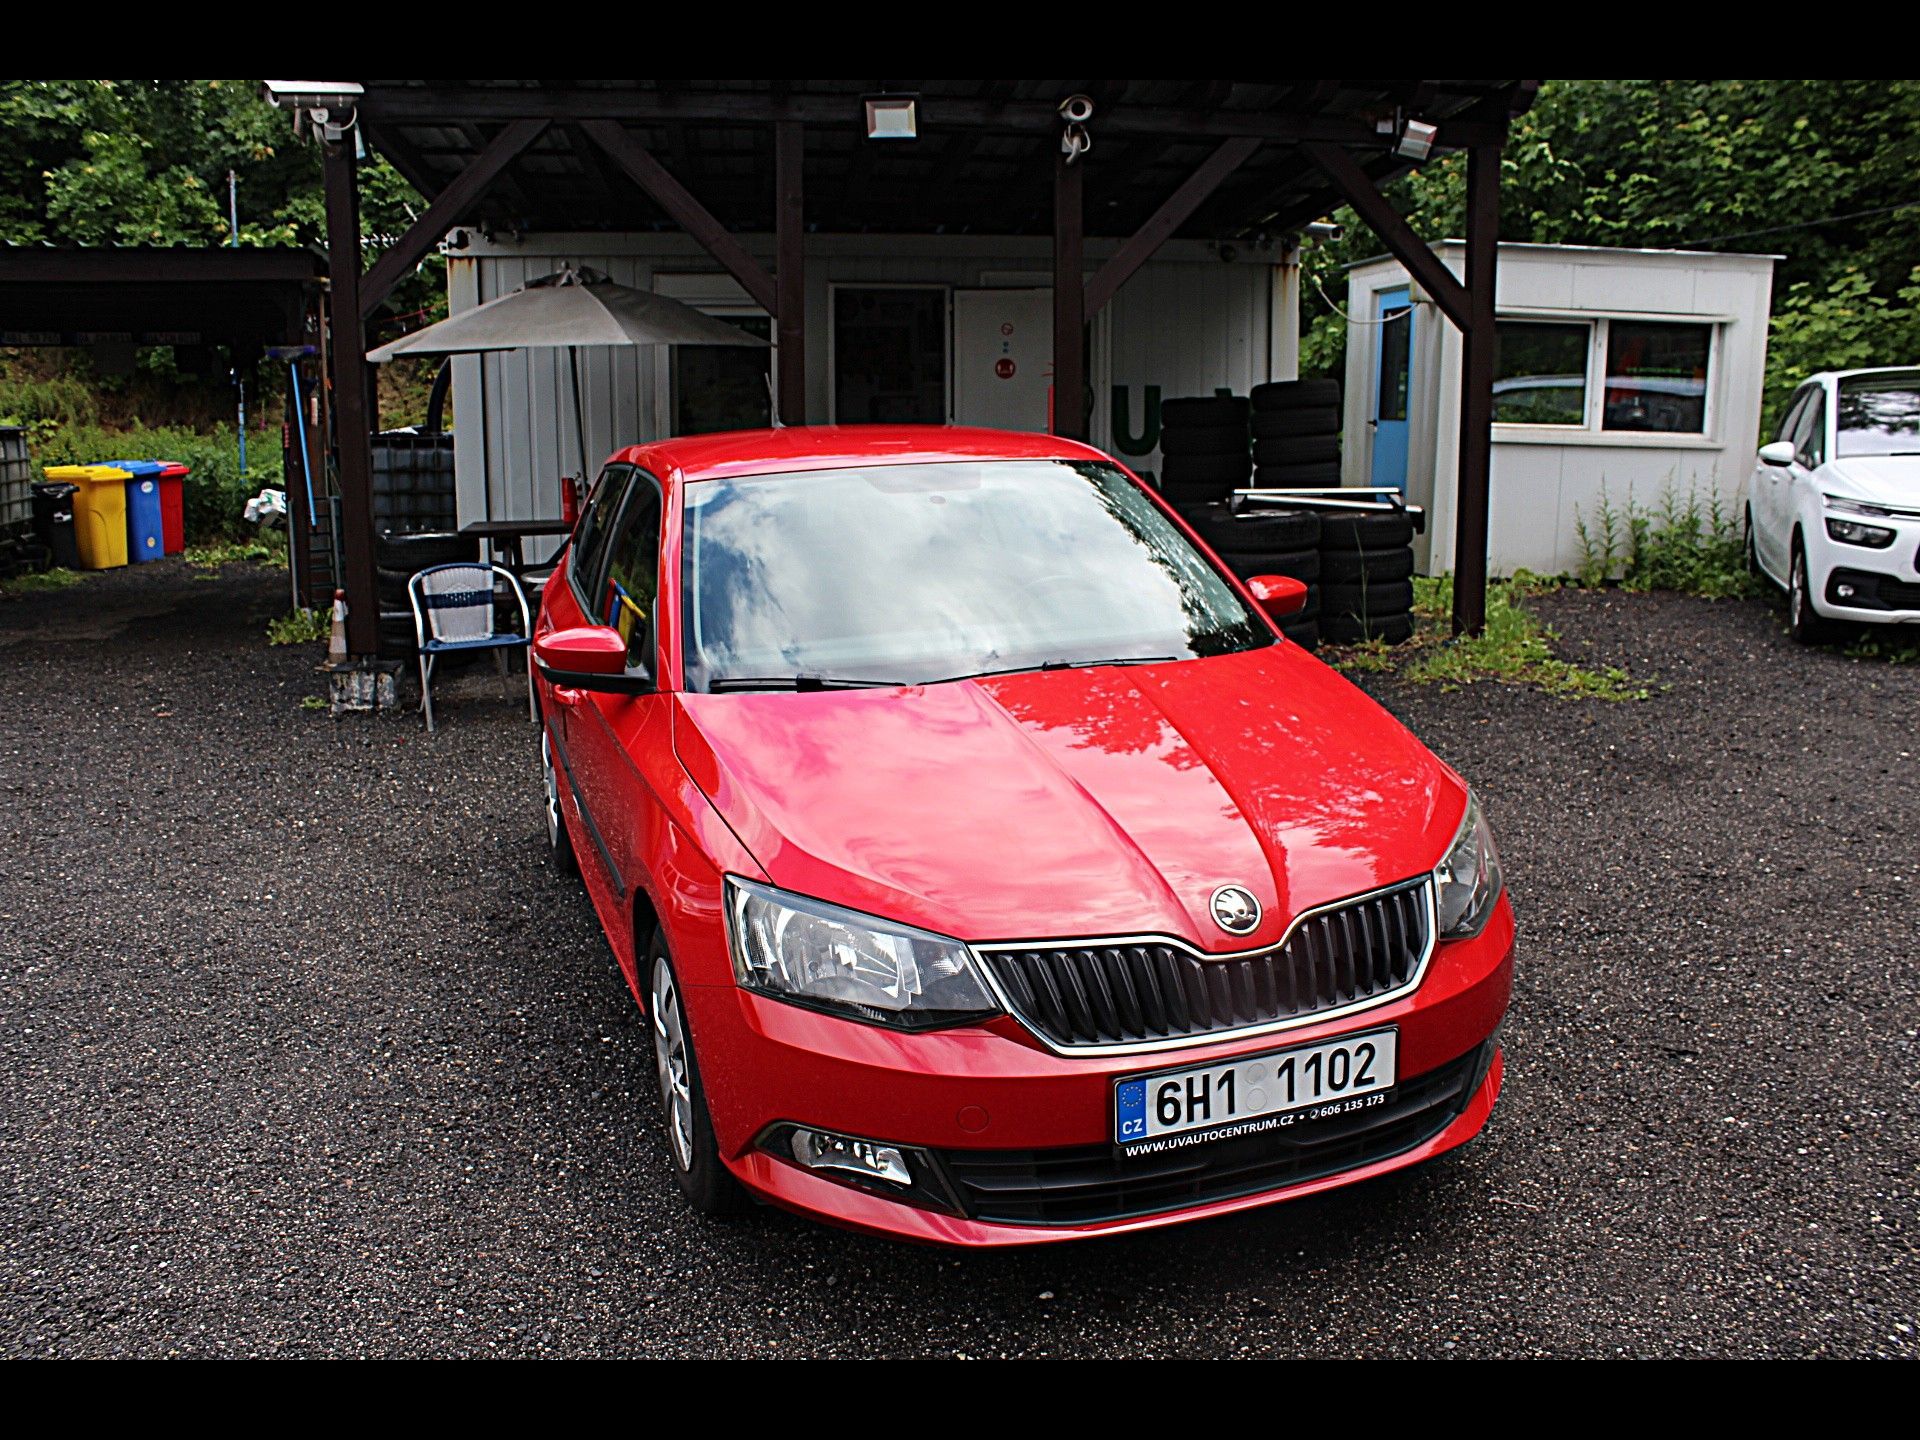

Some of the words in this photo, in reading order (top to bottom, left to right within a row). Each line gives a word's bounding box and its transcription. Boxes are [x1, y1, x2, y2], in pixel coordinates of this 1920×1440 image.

[1156, 1068, 1235, 1126] 6H1
[1277, 1042, 1376, 1103] 1102
[1122, 1118, 1142, 1134] CZ
[1126, 1115, 1294, 1157] WWW.UVAUTOCENTRUM.CZ
[1320, 1106, 1341, 1117] 606
[1344, 1100, 1363, 1112] 135
[1367, 1094, 1385, 1106] 173
